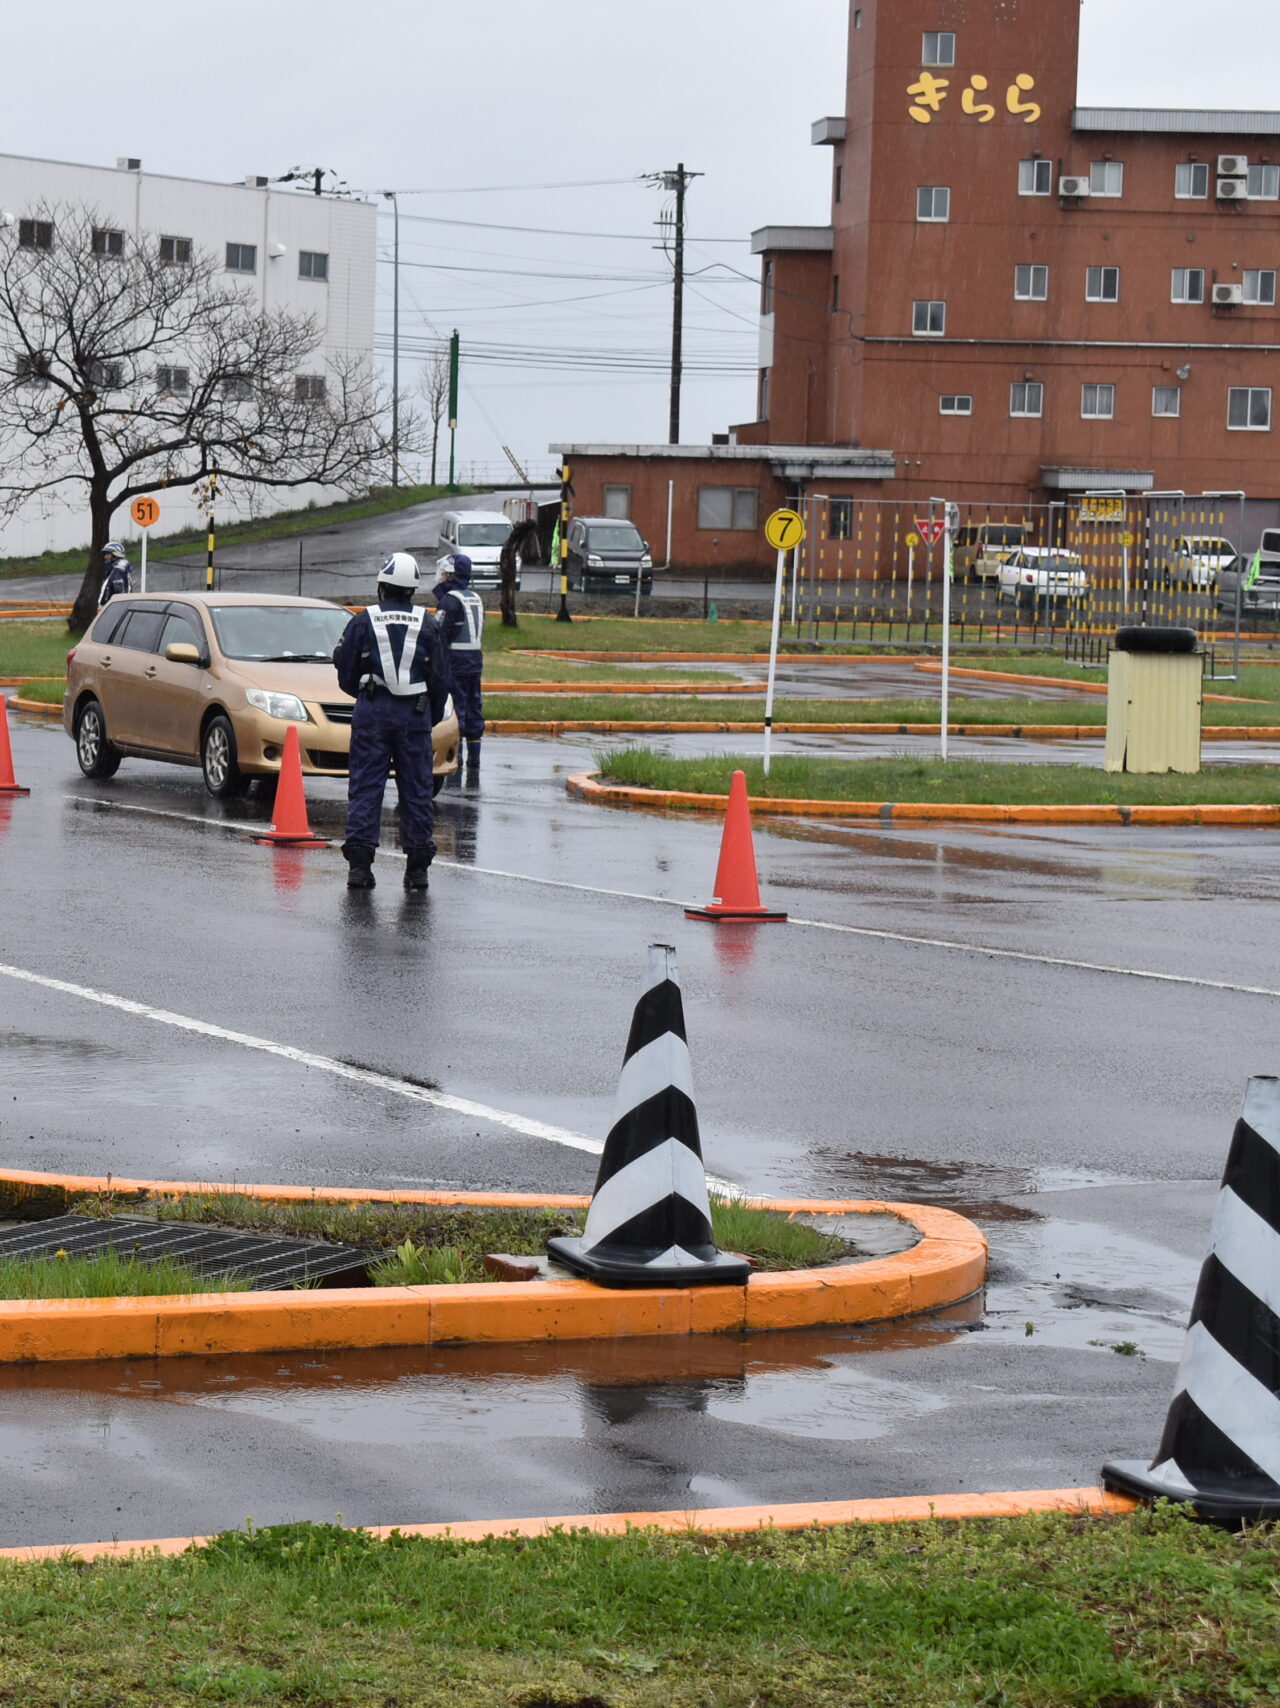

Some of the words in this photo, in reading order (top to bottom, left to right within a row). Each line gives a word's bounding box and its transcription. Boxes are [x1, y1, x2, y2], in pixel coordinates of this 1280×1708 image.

[906, 71, 1041, 123] きらら
[137, 502, 153, 521] 51
[778, 517, 794, 542] 7
